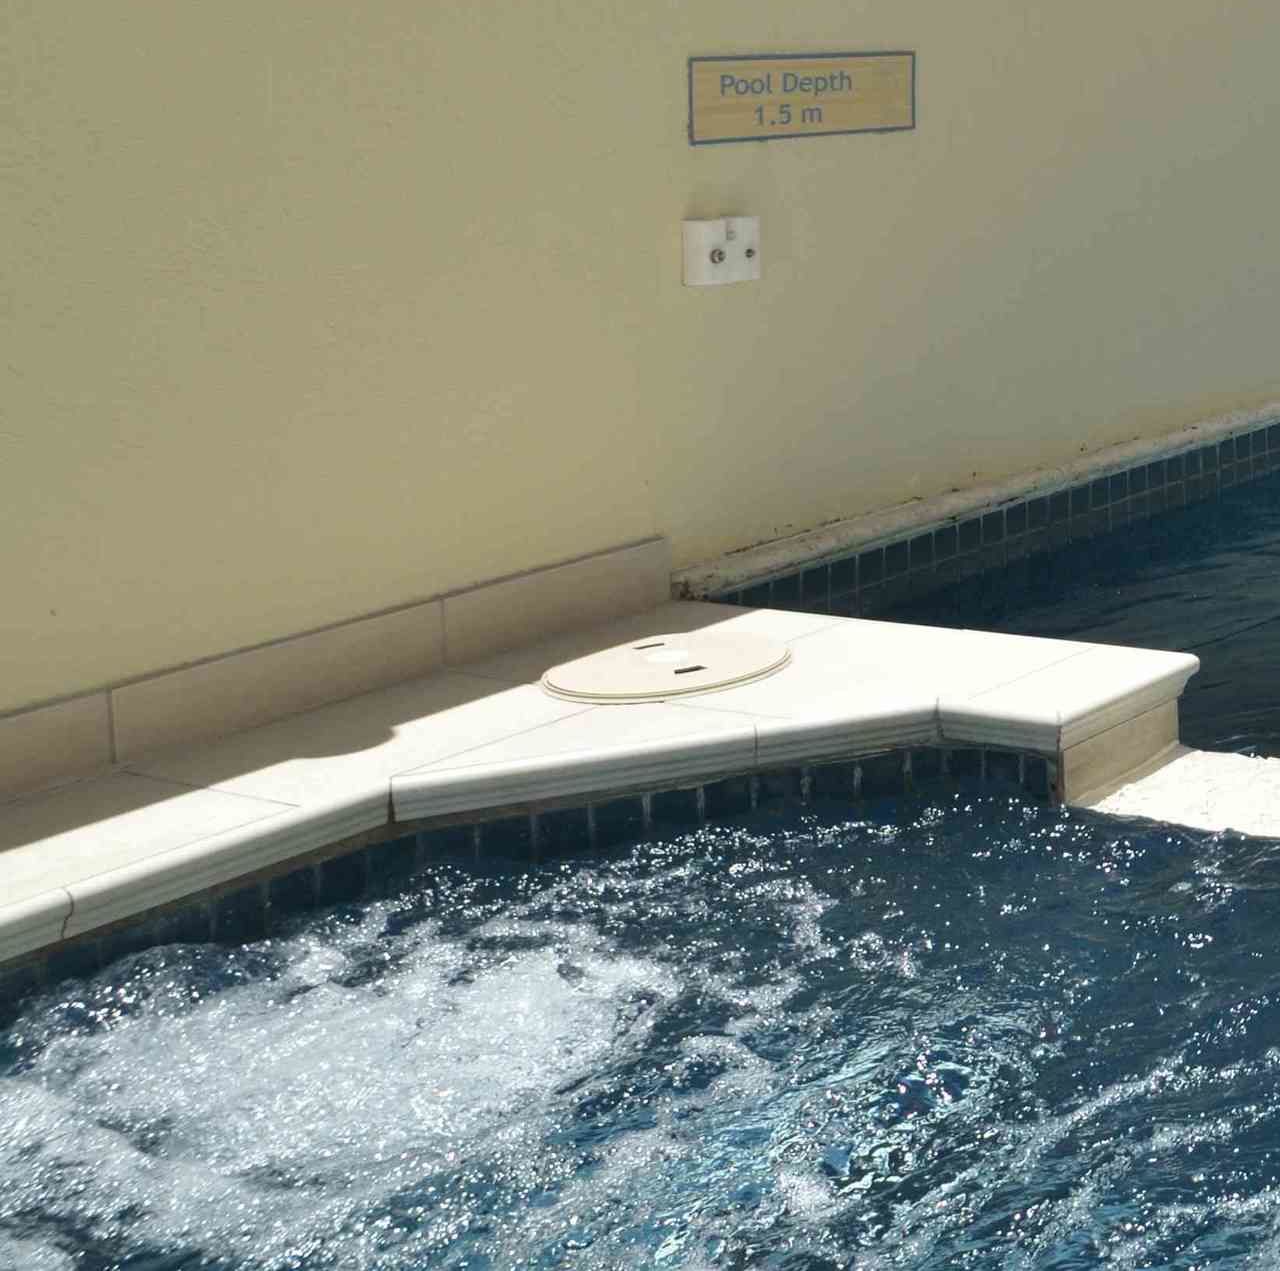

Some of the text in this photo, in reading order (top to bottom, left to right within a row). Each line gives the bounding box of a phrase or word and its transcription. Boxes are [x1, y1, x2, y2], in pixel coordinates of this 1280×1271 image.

[719, 70, 853, 97] Pool Depth
[753, 104, 823, 127] 1.5 m
